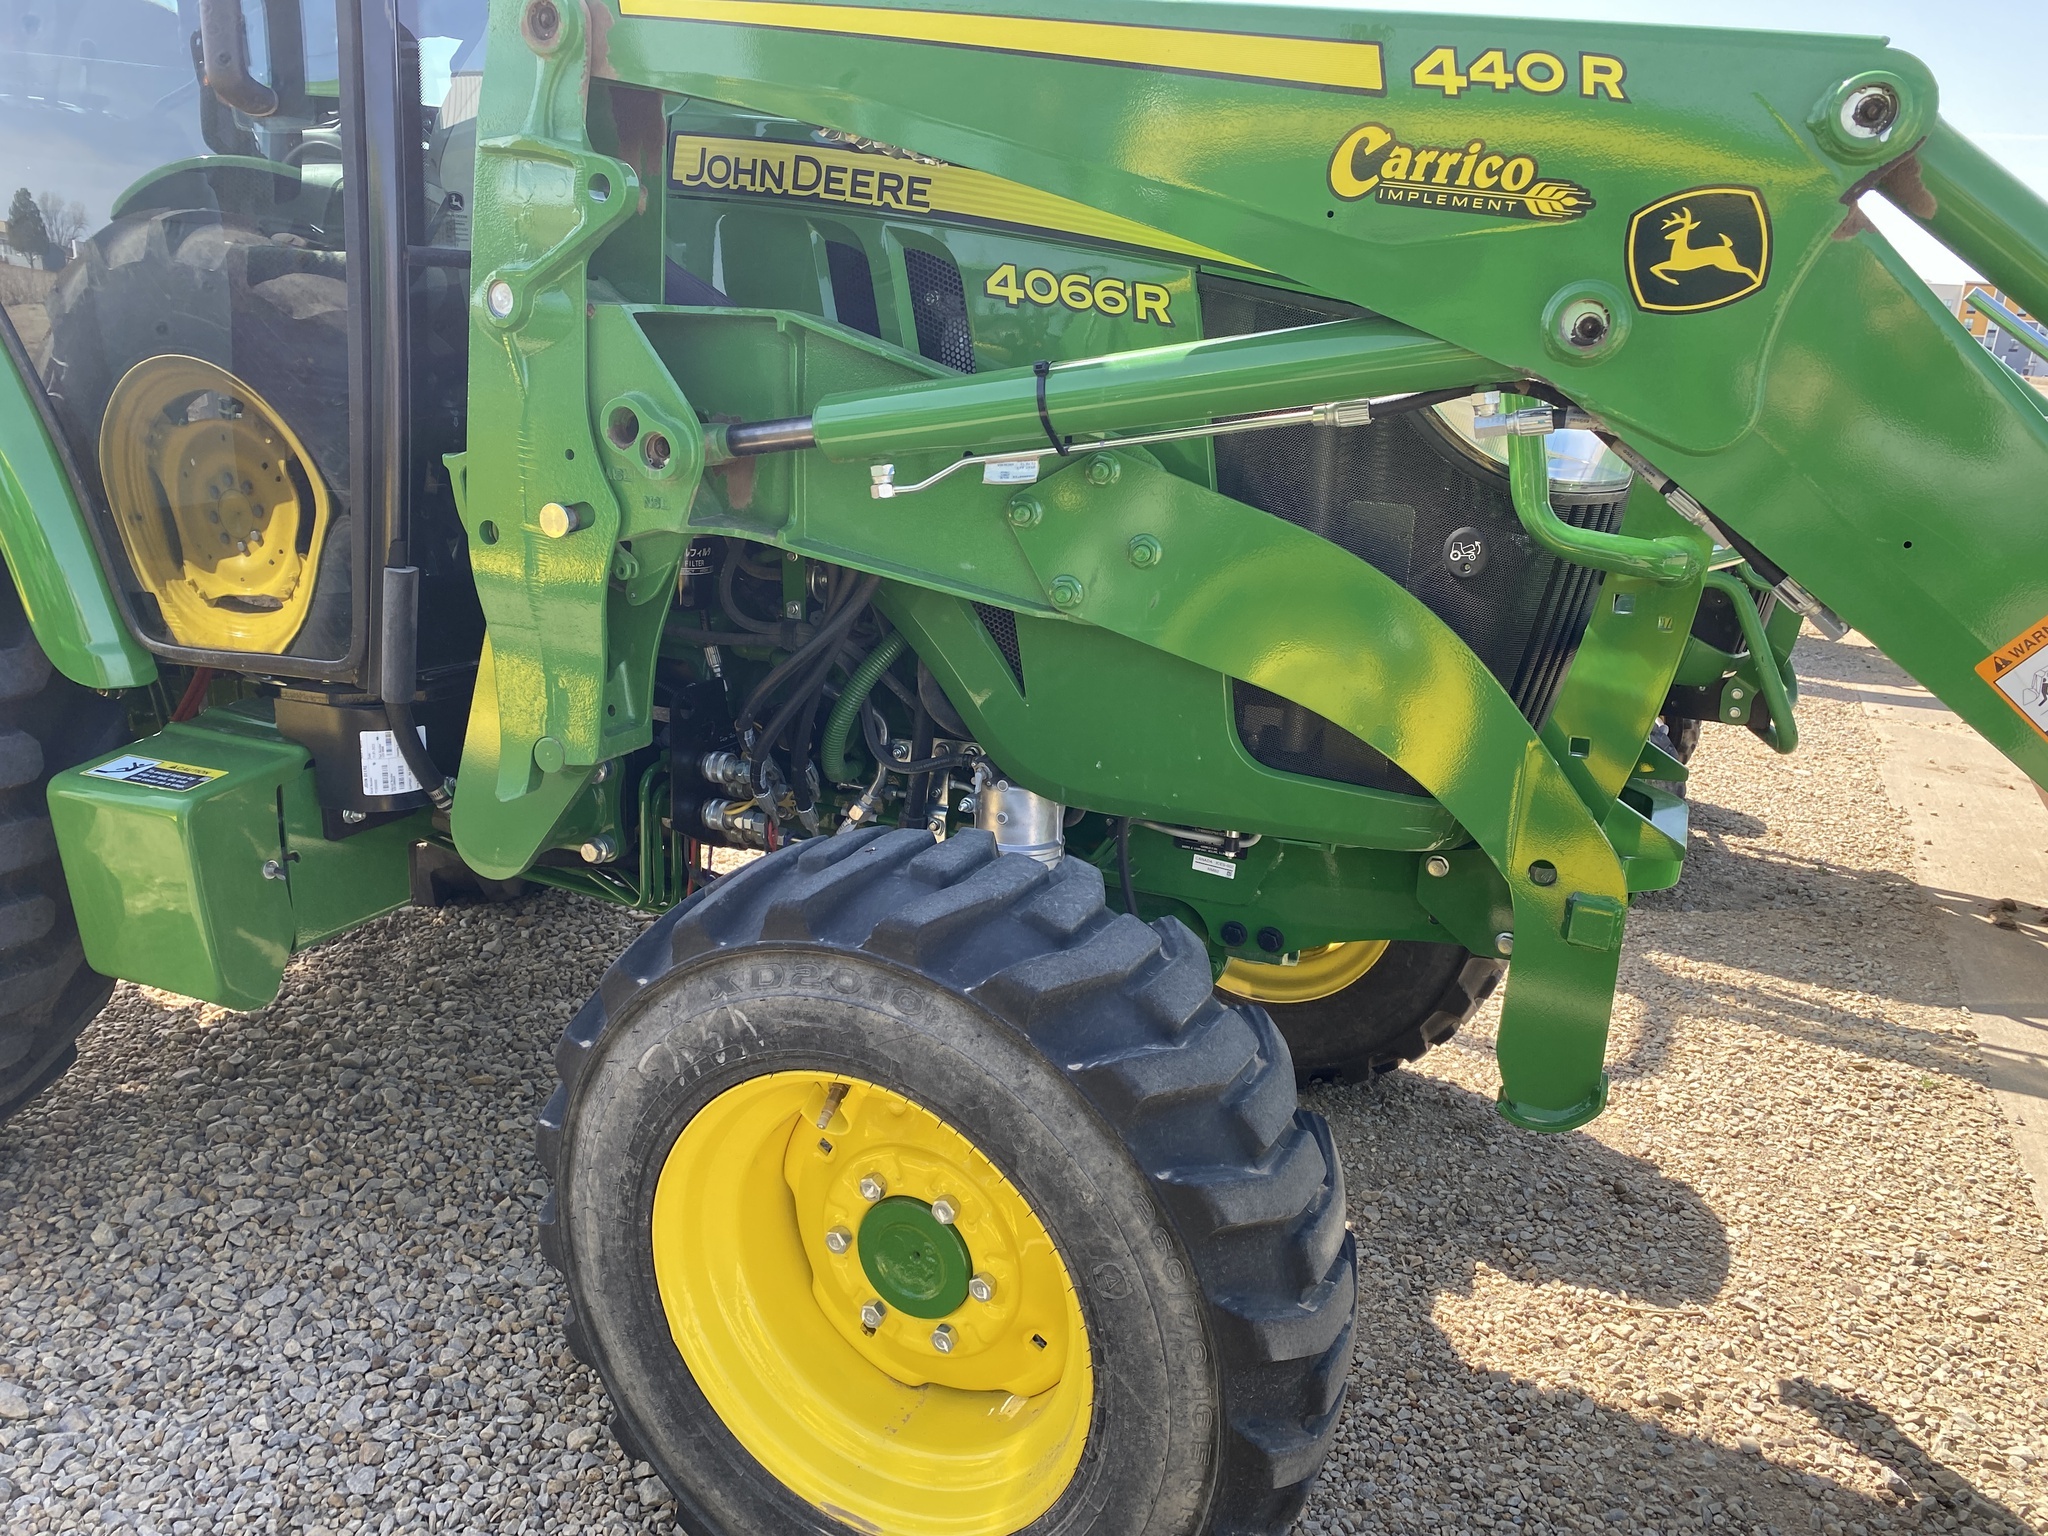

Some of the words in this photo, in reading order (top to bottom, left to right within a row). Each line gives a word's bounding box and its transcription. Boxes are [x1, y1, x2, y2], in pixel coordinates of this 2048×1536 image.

[1413, 48, 1566, 96] 440
[1581, 54, 1625, 99] R
[686, 147, 785, 190] JOHN
[792, 154, 933, 209] DEERE
[1330, 126, 1535, 198] Carrico
[1379, 187, 1518, 213] IMPLEMENT
[684, 559, 705, 568] FILTER
[177, 766, 212, 775] CAUTION
[710, 963, 925, 1016] XD2010
